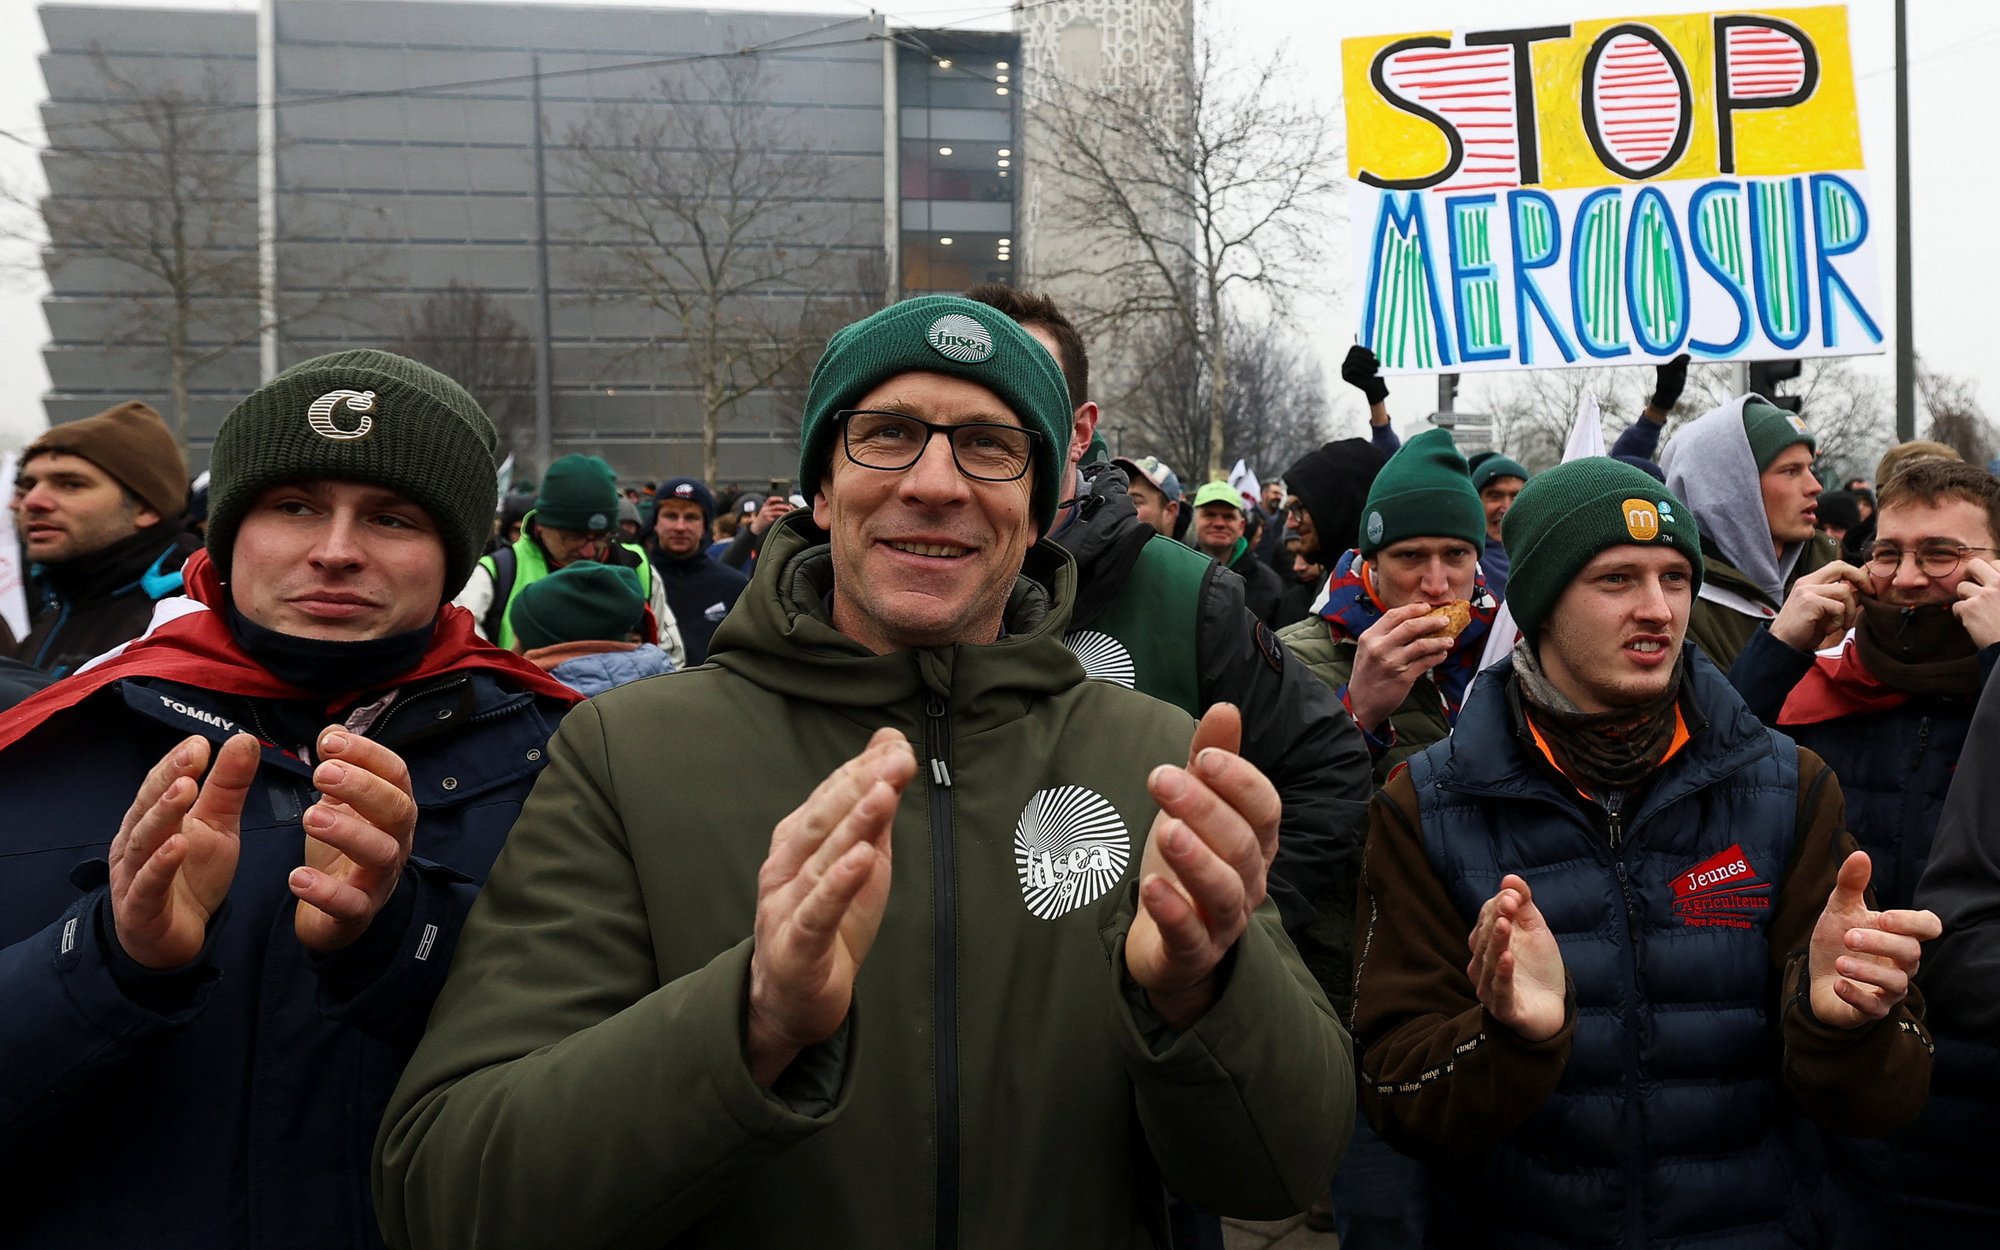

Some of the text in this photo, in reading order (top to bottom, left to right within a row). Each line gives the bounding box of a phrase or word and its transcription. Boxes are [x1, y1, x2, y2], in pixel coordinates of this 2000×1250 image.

[1358, 14, 1818, 190] STOP
[1356, 173, 1884, 368] MERCOSUR
[937, 331, 986, 353] fnsea
[308, 389, 376, 439] C
[1629, 510, 1655, 528] m
[1662, 534, 1673, 543] TM
[160, 695, 234, 731] TOMMY
[1026, 845, 1113, 890] fdsea
[1687, 859, 1747, 891] Jeunes
[1061, 882, 1073, 898] 59
[1681, 893, 1769, 913] Agriculteurs
